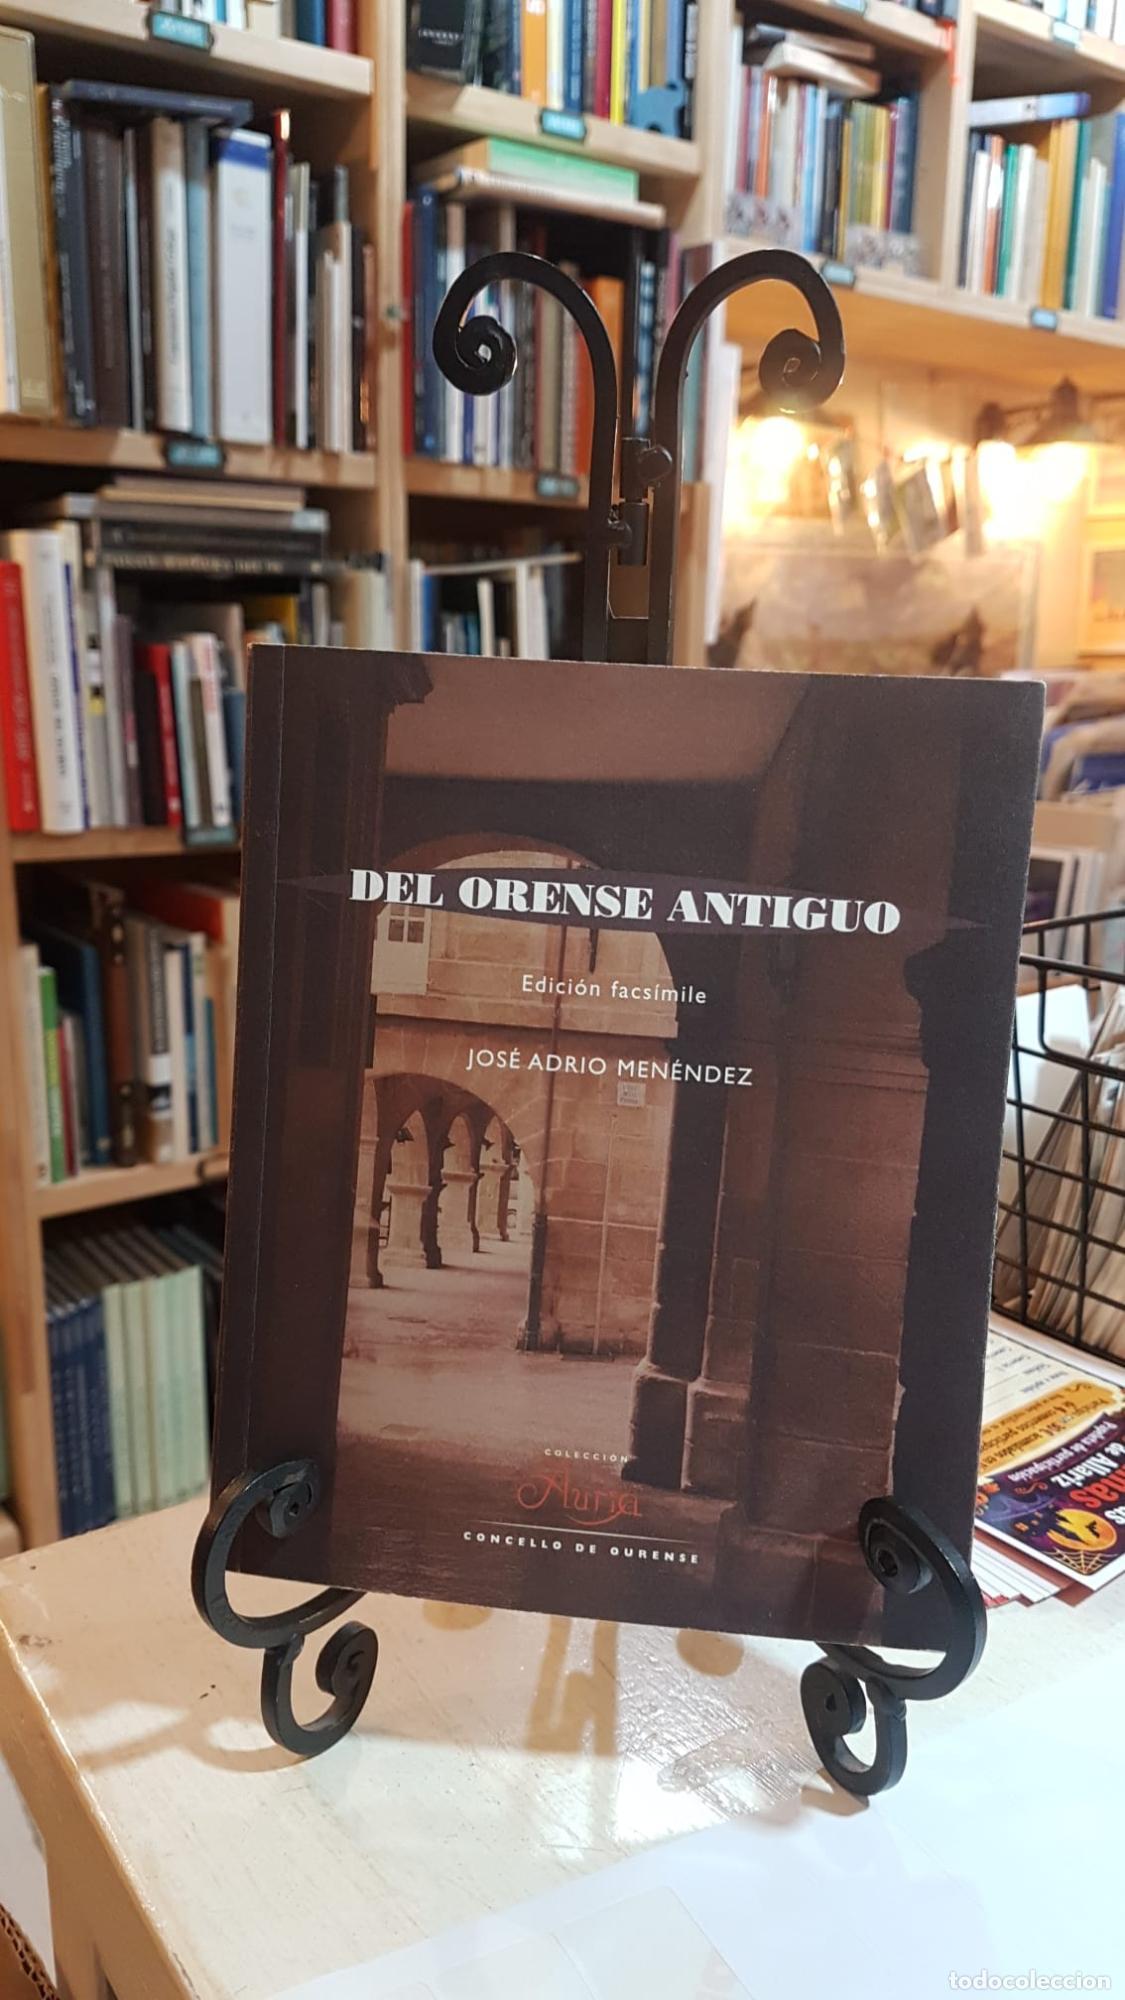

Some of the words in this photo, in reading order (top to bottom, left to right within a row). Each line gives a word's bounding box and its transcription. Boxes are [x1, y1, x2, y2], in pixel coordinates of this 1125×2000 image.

[349, 868, 444, 908] DEL
[459, 876, 653, 921] ORENSE
[665, 889, 901, 935] ANTIGUO
[522, 974, 601, 997] Edición
[611, 980, 707, 1004] facsímile
[465, 1047, 521, 1071] JOSÉ
[527, 1054, 607, 1076] ADRIO
[617, 1058, 754, 1086] MENÉNDEZ
[1007, 1446, 1075, 1483] participación
[1050, 1452, 1119, 1488] Allariz
[463, 1530, 562, 1551] CONCELLO
[575, 1542, 597, 1555] DE
[610, 1546, 699, 1565] OURENSE
